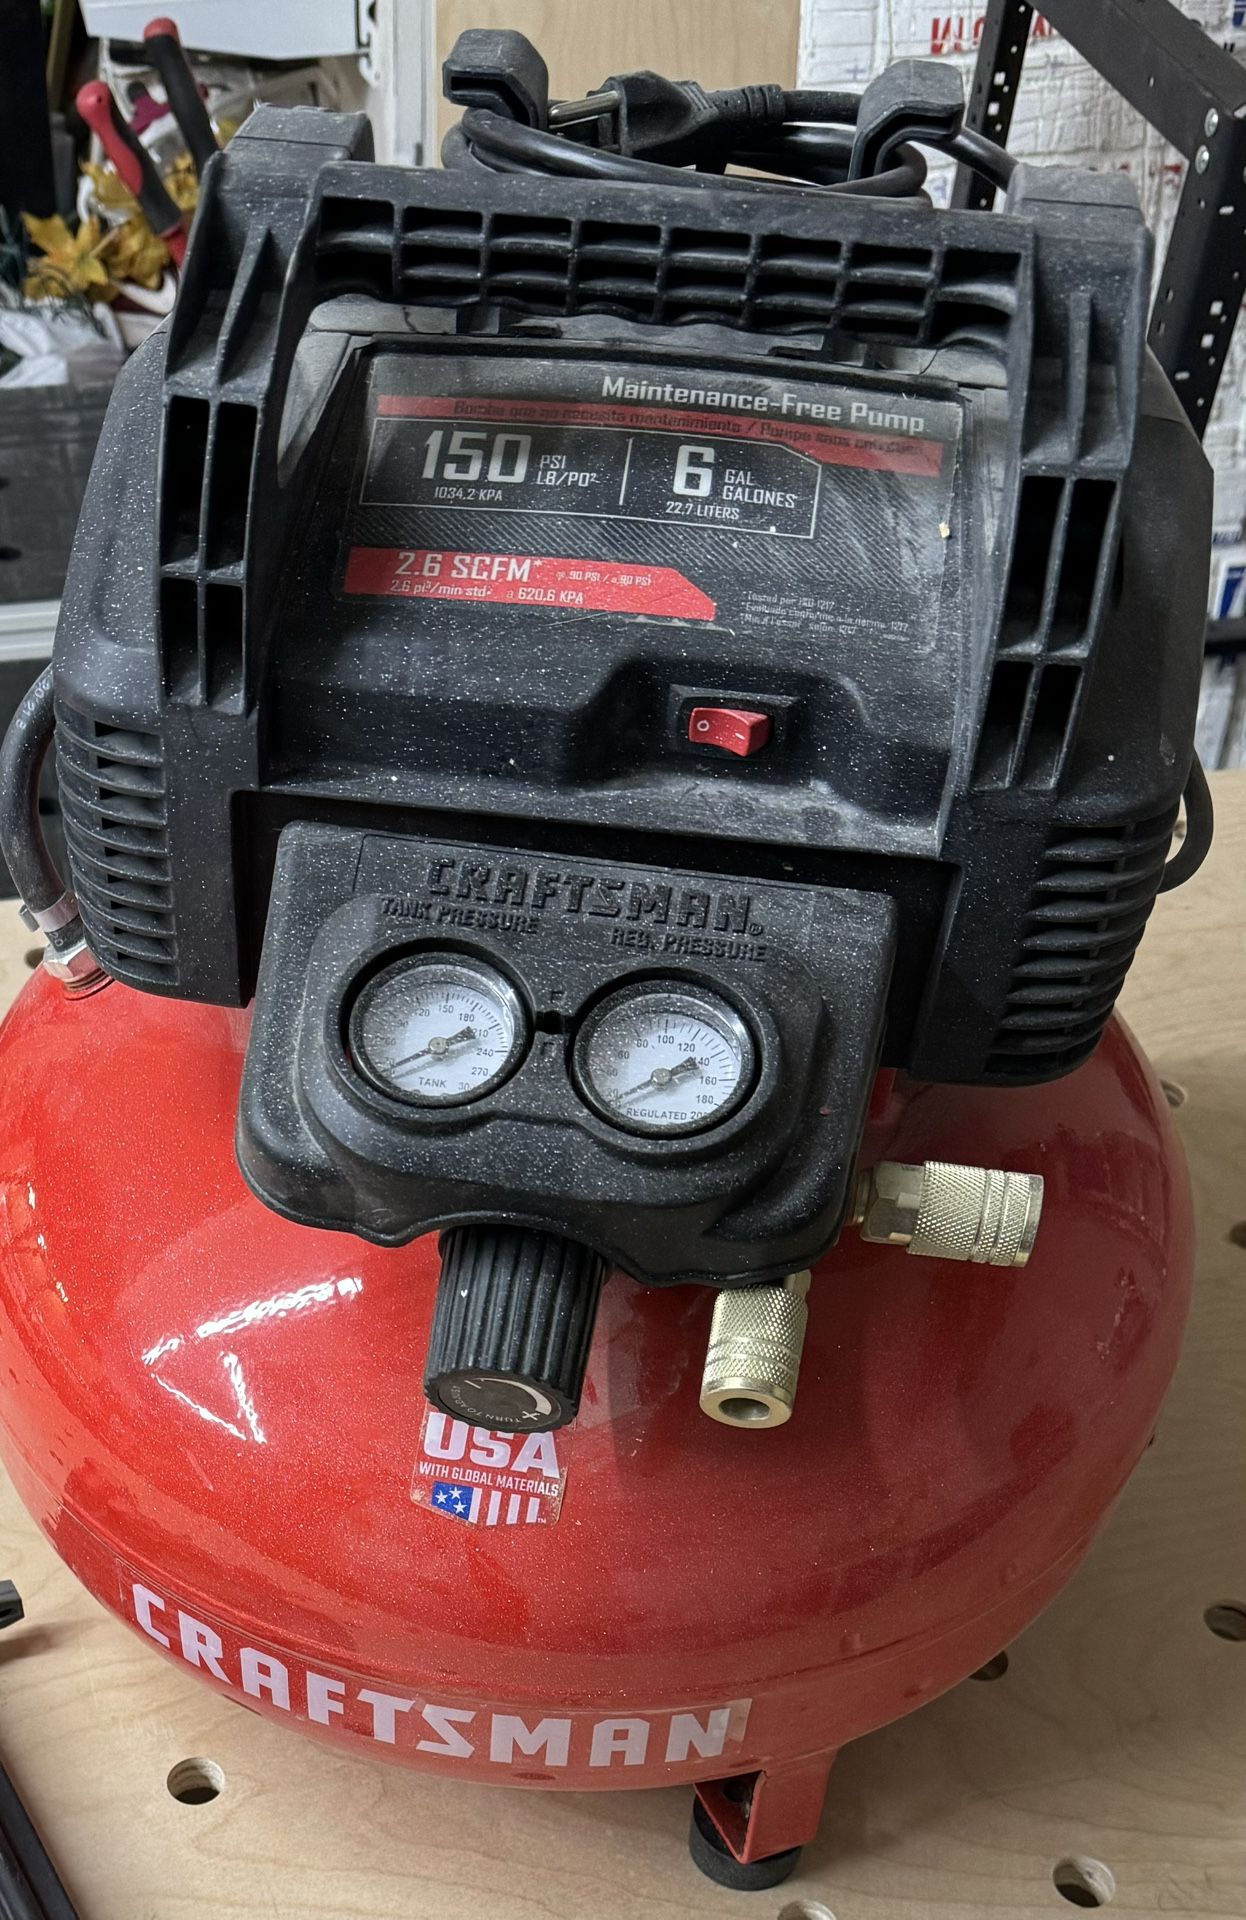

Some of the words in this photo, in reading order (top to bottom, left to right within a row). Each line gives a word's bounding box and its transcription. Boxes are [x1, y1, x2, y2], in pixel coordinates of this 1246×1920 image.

[602, 375, 841, 421] Maintenance-Free
[850, 403, 925, 436] Pump
[422, 430, 532, 483] 150
[540, 454, 566, 470] PSI
[672, 444, 715, 498] 6
[724, 468, 755, 487] GAL
[434, 486, 476, 501] 1034.2
[478, 487, 503, 501] KPA
[722, 485, 797, 509] GALONES
[665, 500, 693, 516] 22.7
[697, 503, 740, 520] LITERS
[395, 551, 442, 577] 2.6
[390, 579, 411, 592] 2.6
[518, 587, 556, 601] 620.6
[559, 589, 584, 605] KPA
[381, 898, 433, 919] TANK
[437, 904, 538, 935] PRESSURE
[662, 933, 767, 962] PRESSURE
[438, 1004, 454, 1014] 150
[459, 1013, 475, 1022] 180
[657, 1035, 675, 1044] 100
[678, 1043, 696, 1052] 120
[476, 1048, 494, 1057] 240
[471, 1067, 489, 1076] 270
[418, 1076, 448, 1089] TANK
[458, 1082, 472, 1091] 30
[700, 1076, 717, 1085] 160
[696, 1095, 714, 1104] 180
[626, 1107, 687, 1120] REGULATED
[690, 1111, 710, 1120] 20
[423, 1411, 560, 1479] USA
[419, 1461, 449, 1479] WITH
[451, 1467, 493, 1487] GLOBAL
[495, 1475, 560, 1498] MATERIALS
[131, 1582, 732, 1768] CRAFTSMAN
